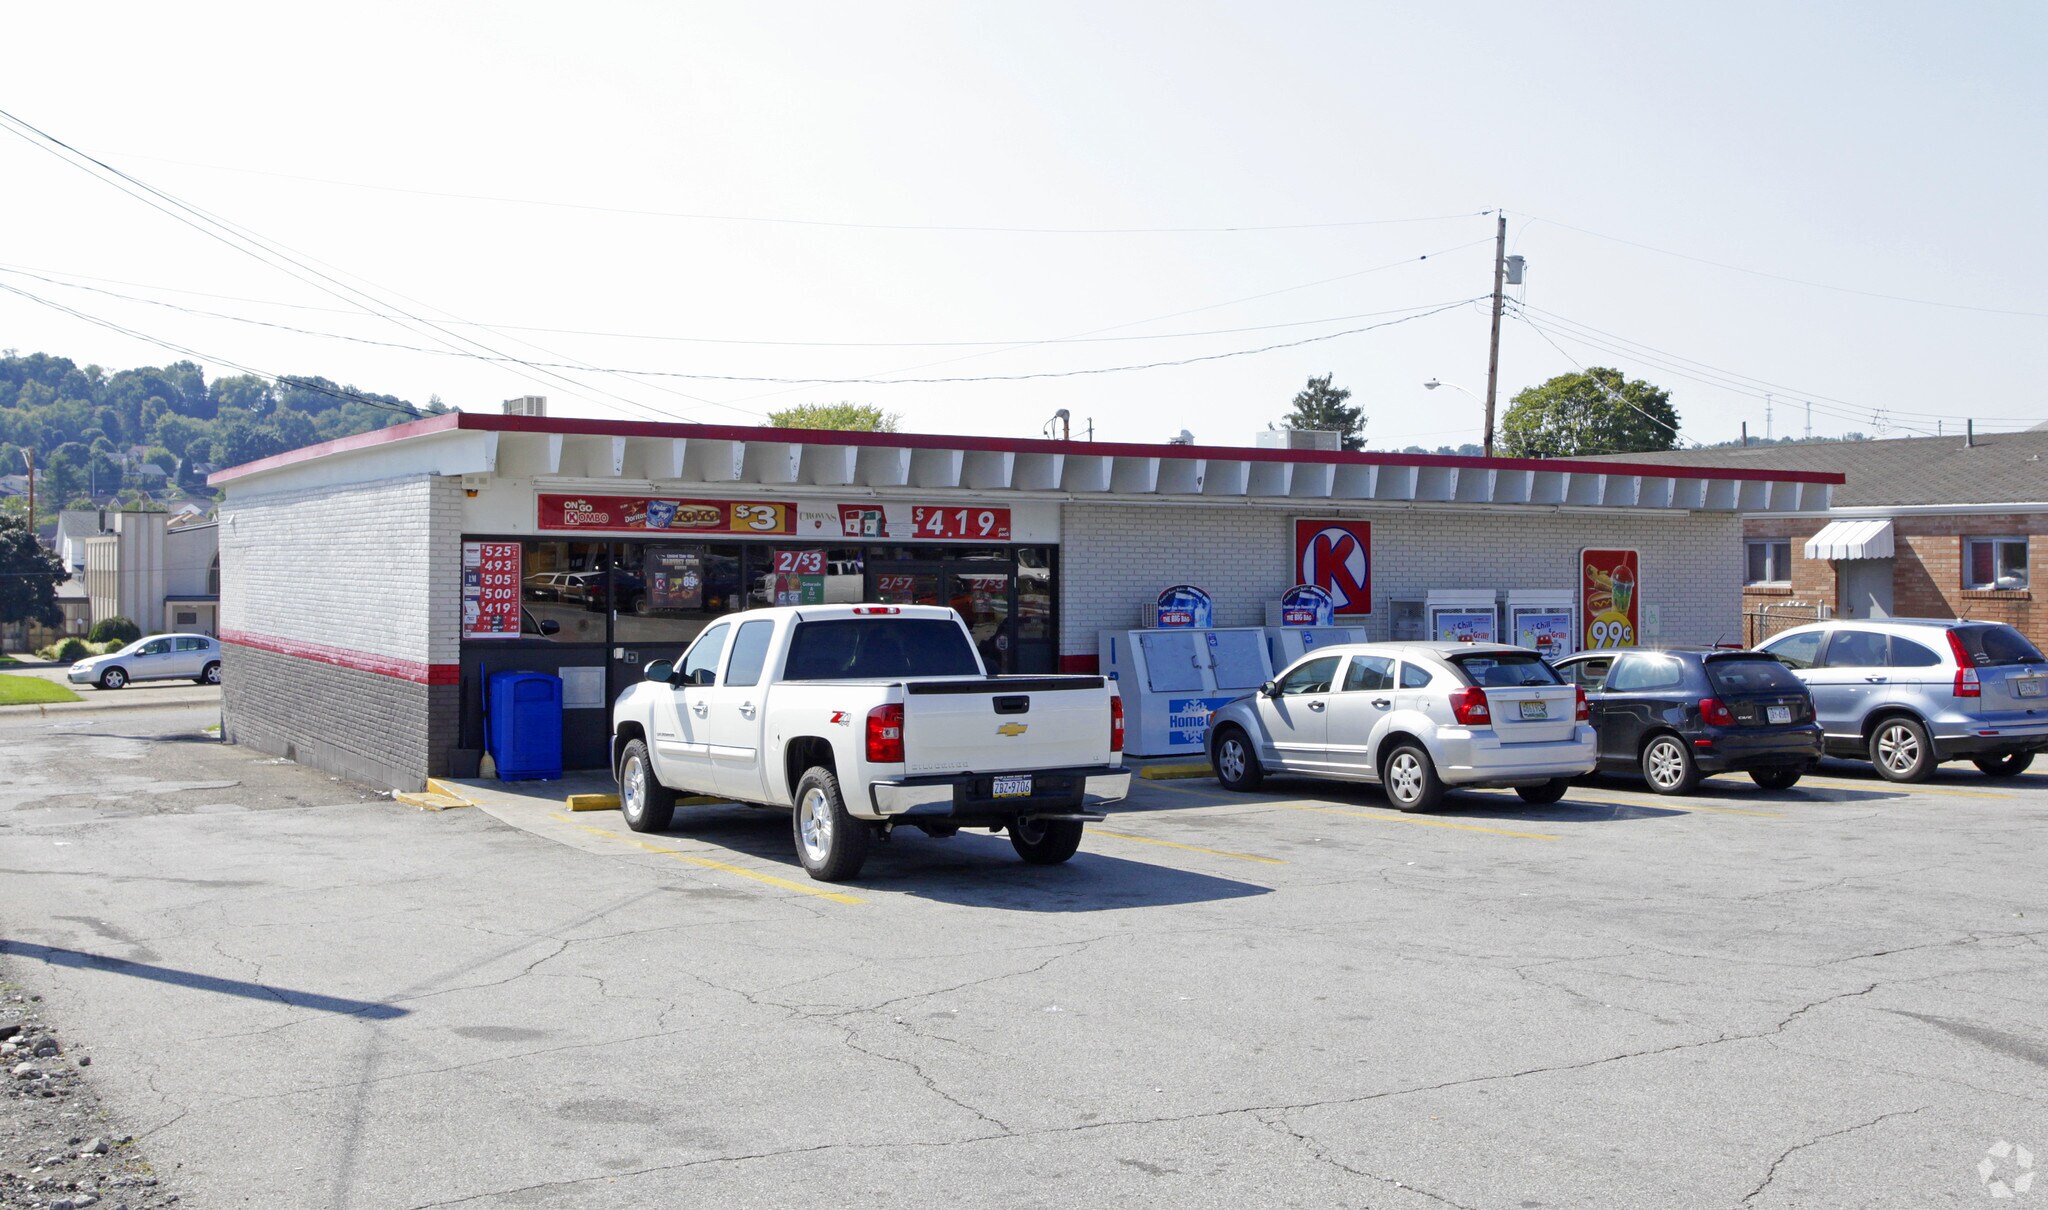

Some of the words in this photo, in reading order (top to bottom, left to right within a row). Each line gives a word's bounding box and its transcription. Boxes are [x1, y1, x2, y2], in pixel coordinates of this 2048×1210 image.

[564, 501, 578, 509] ON
[579, 504, 593, 512] GO
[564, 510, 609, 525] KOMBO
[625, 512, 647, 523] Doritos
[735, 504, 777, 531] $3
[799, 511, 837, 522] CROWNS
[915, 508, 995, 536] $4.19
[779, 552, 821, 572] 2/$3
[1314, 533, 1362, 604] K
[879, 577, 913, 590] 2/$7
[1171, 614, 1180, 623] BIG
[1181, 615, 1190, 623] BAG
[1294, 613, 1303, 621] BIG
[1457, 621, 1472, 630] Chill
[1535, 621, 1551, 630] Chill
[1473, 631, 1489, 640] Grill!
[1551, 630, 1567, 639] Grill!
[1592, 620, 1631, 649] 99¢
[1170, 715, 1204, 728] Home
